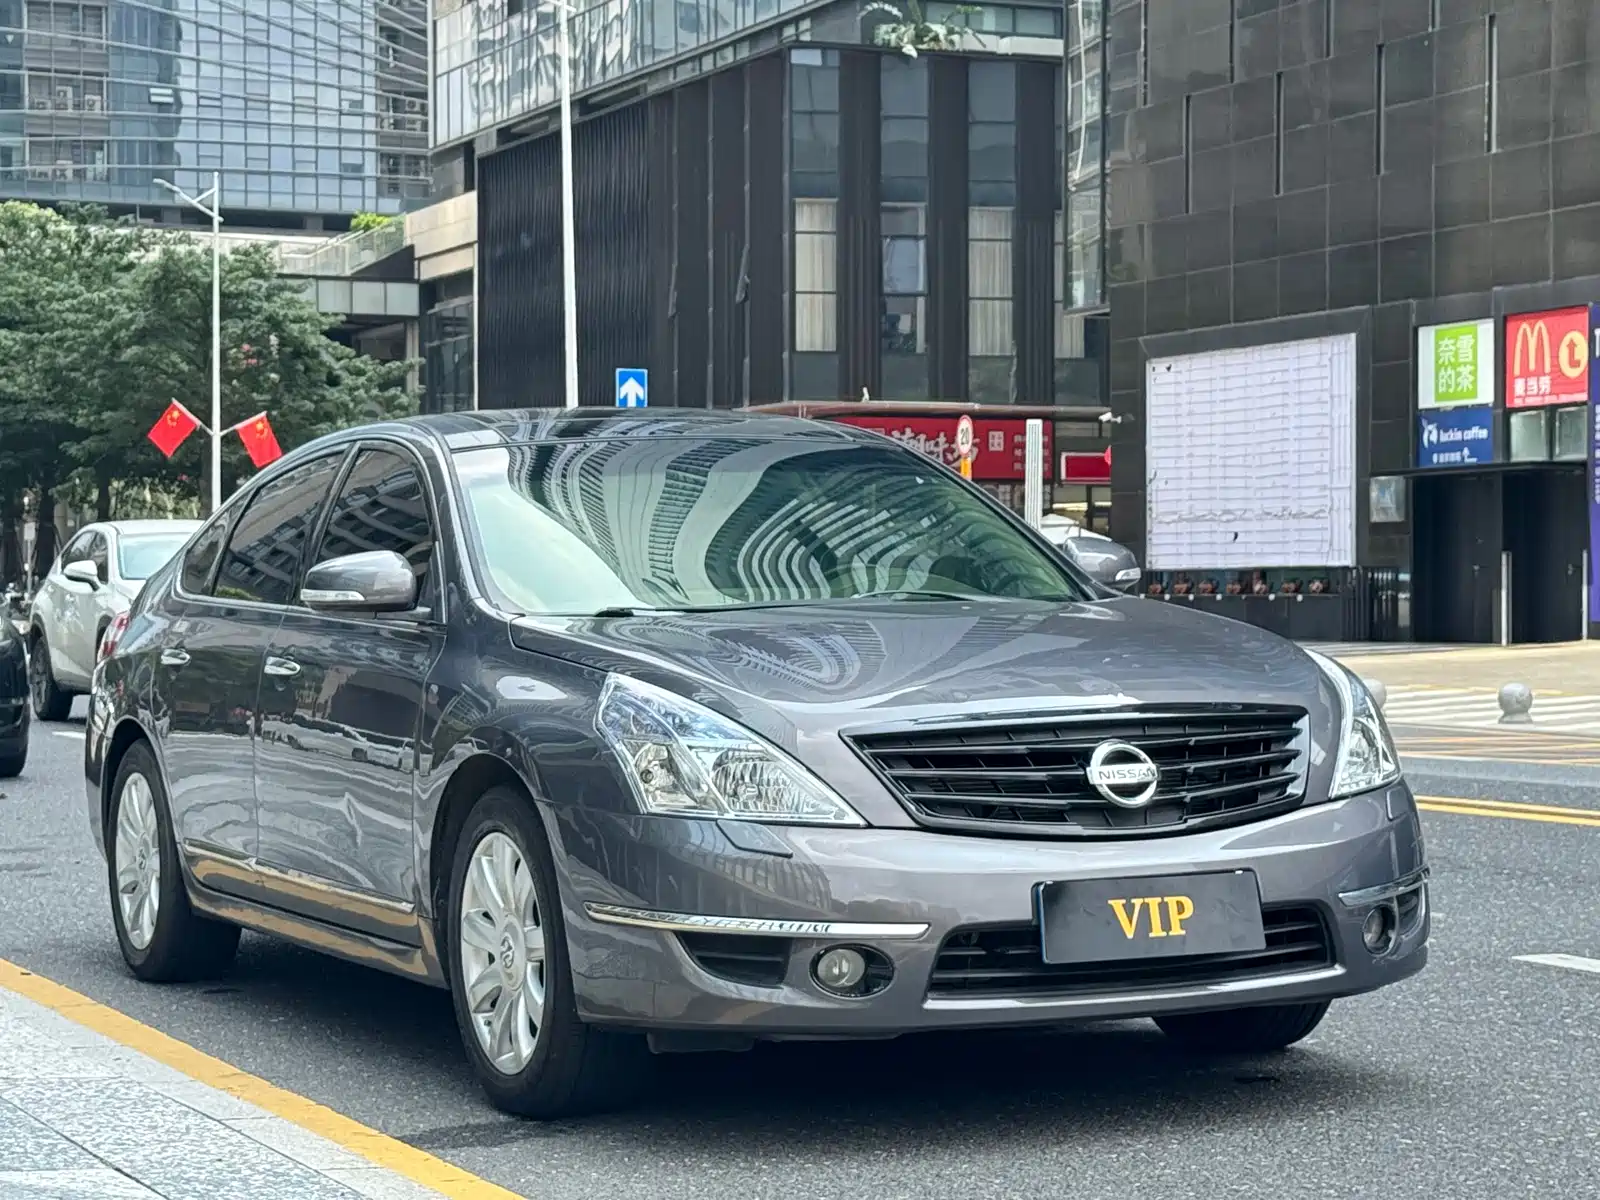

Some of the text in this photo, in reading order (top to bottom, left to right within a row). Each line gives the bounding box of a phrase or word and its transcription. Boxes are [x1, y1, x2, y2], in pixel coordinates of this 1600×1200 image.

[1438, 335, 1475, 365] 奈雪
[1438, 364, 1475, 394] 的茶
[960, 427, 970, 446] 20
[1439, 425, 1489, 443] luckin coffee
[1097, 767, 1157, 781] NISSAN
[1107, 895, 1195, 939] VIP
